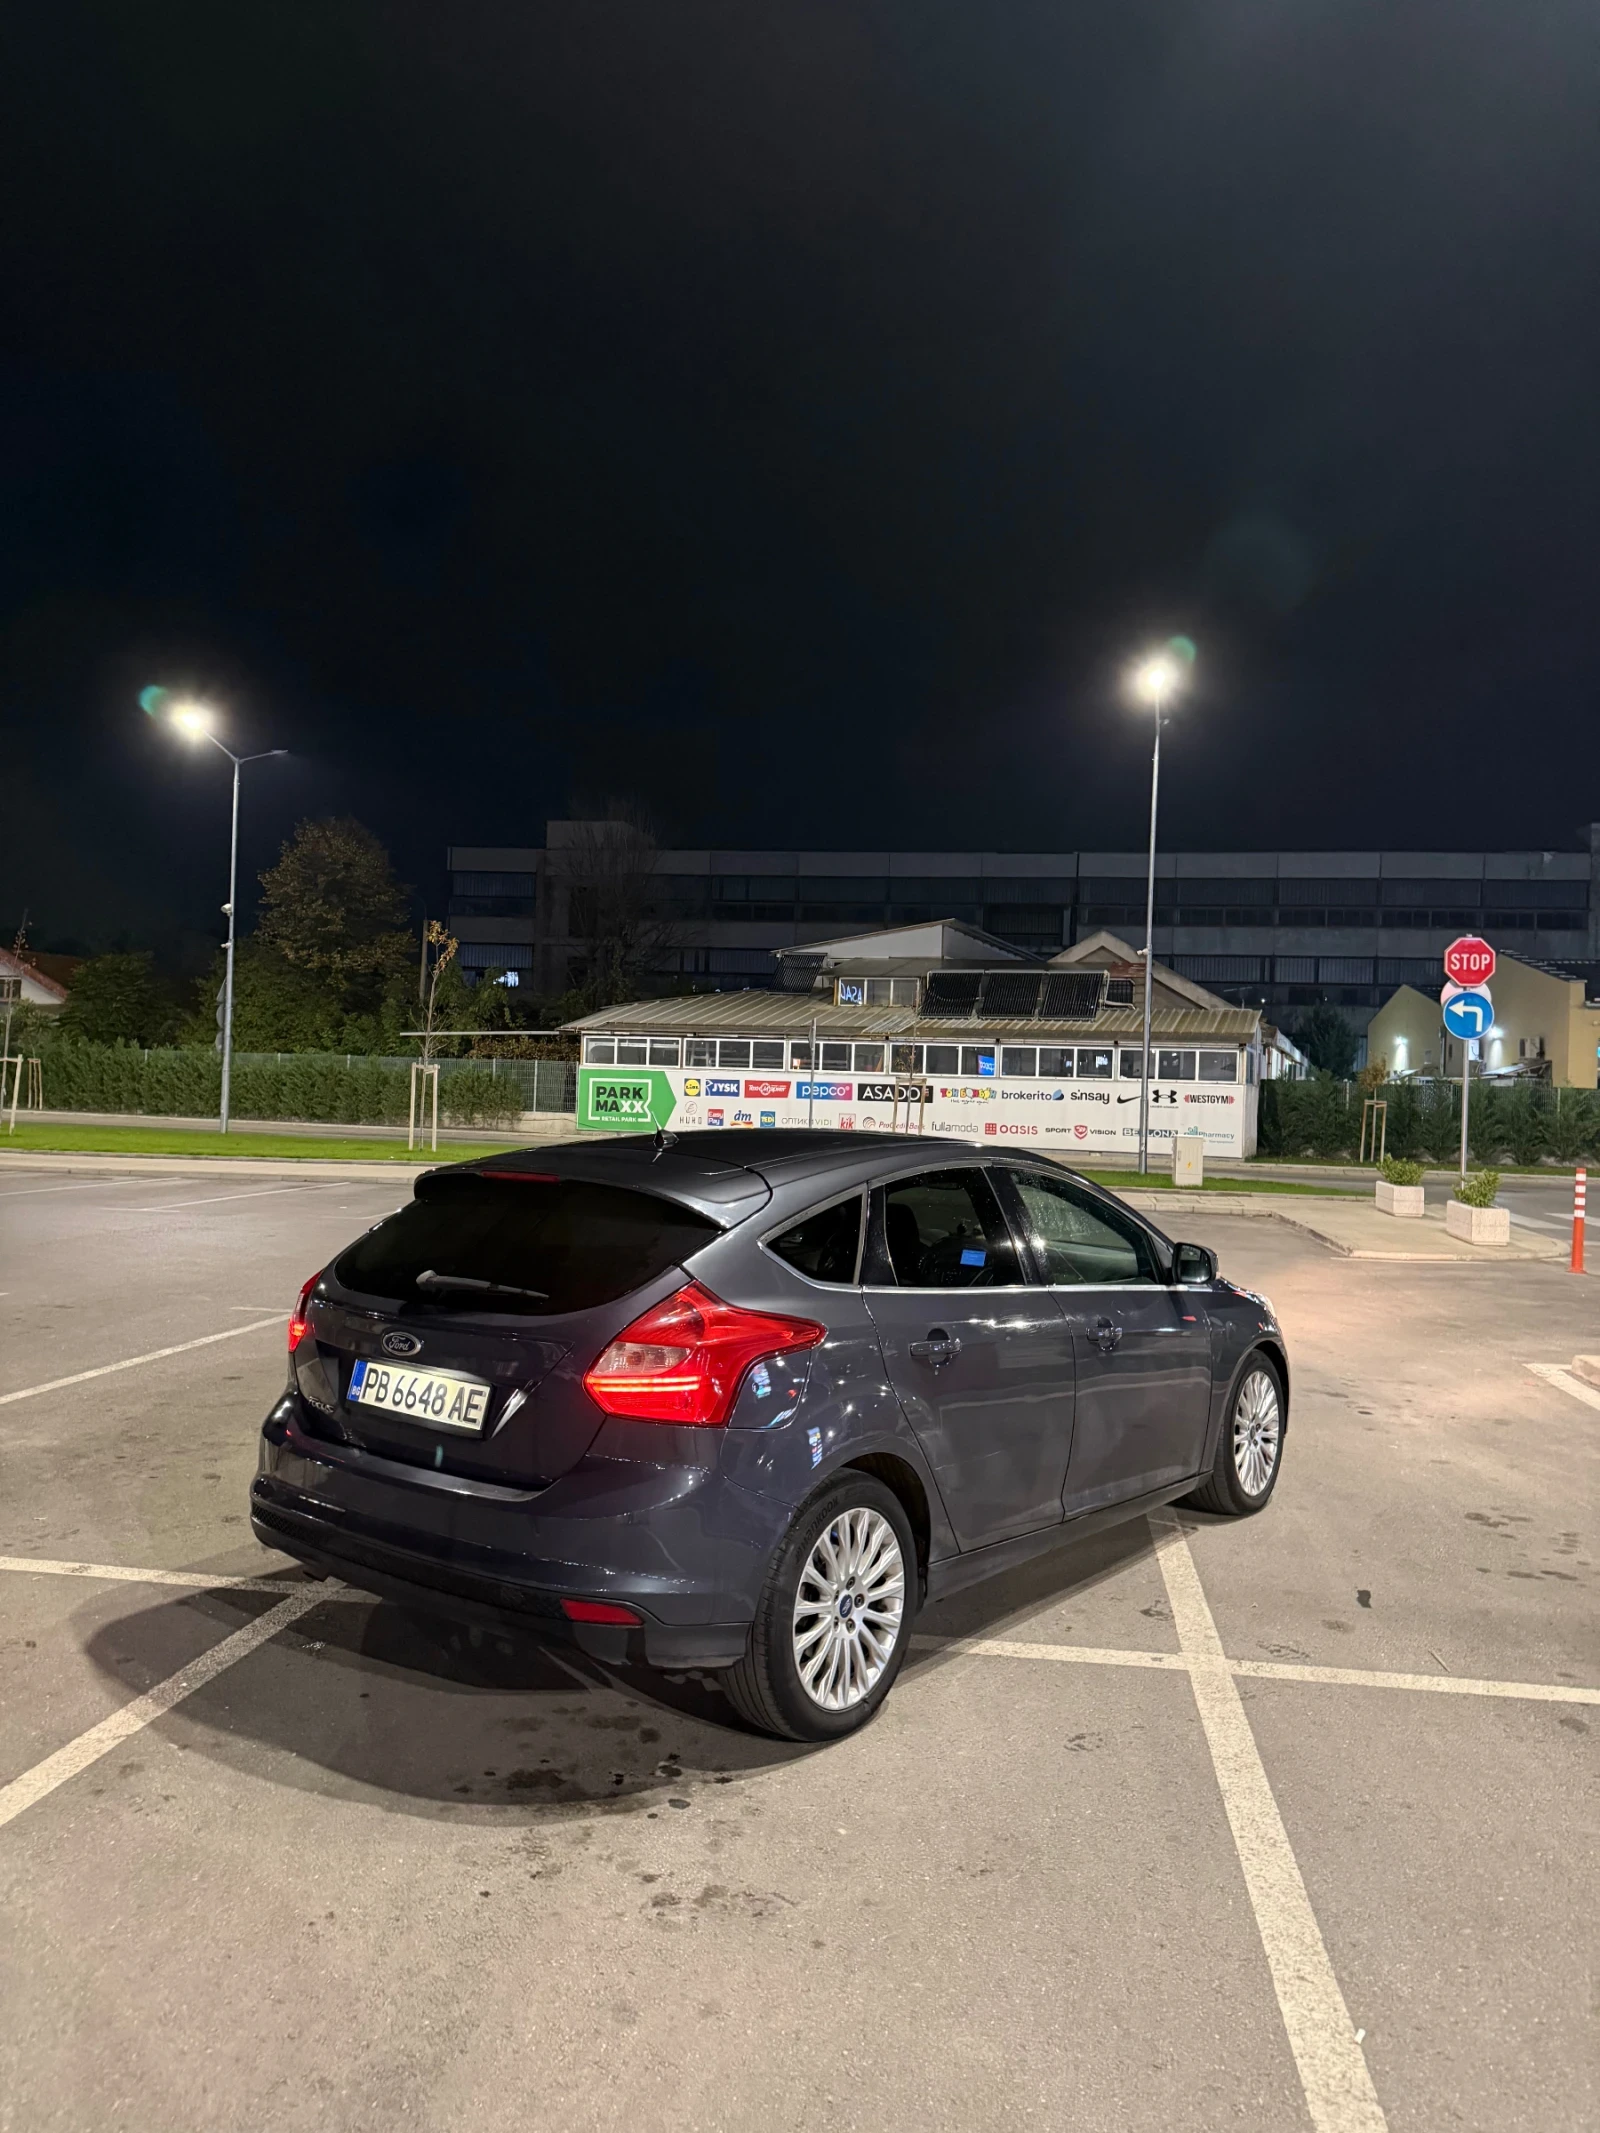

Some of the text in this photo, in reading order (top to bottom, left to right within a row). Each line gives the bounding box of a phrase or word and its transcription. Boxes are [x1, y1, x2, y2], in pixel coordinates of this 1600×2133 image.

[1450, 953, 1491, 971] STOP
[596, 1086, 643, 1099] PARK
[712, 1083, 738, 1093] JYSK
[802, 1085, 846, 1098] pepco
[1002, 1090, 1052, 1101] brokerito
[1070, 1089, 1110, 1105] sinsay
[1189, 1094, 1229, 1105] WESTGYM
[596, 1100, 644, 1113] MAXX
[734, 1109, 752, 1121] dm
[931, 1121, 979, 1133] fullamoda
[1000, 1124, 1038, 1135] oasis
[1199, 1131, 1235, 1140] Pharmacy
[388, 1336, 411, 1351] Ford
